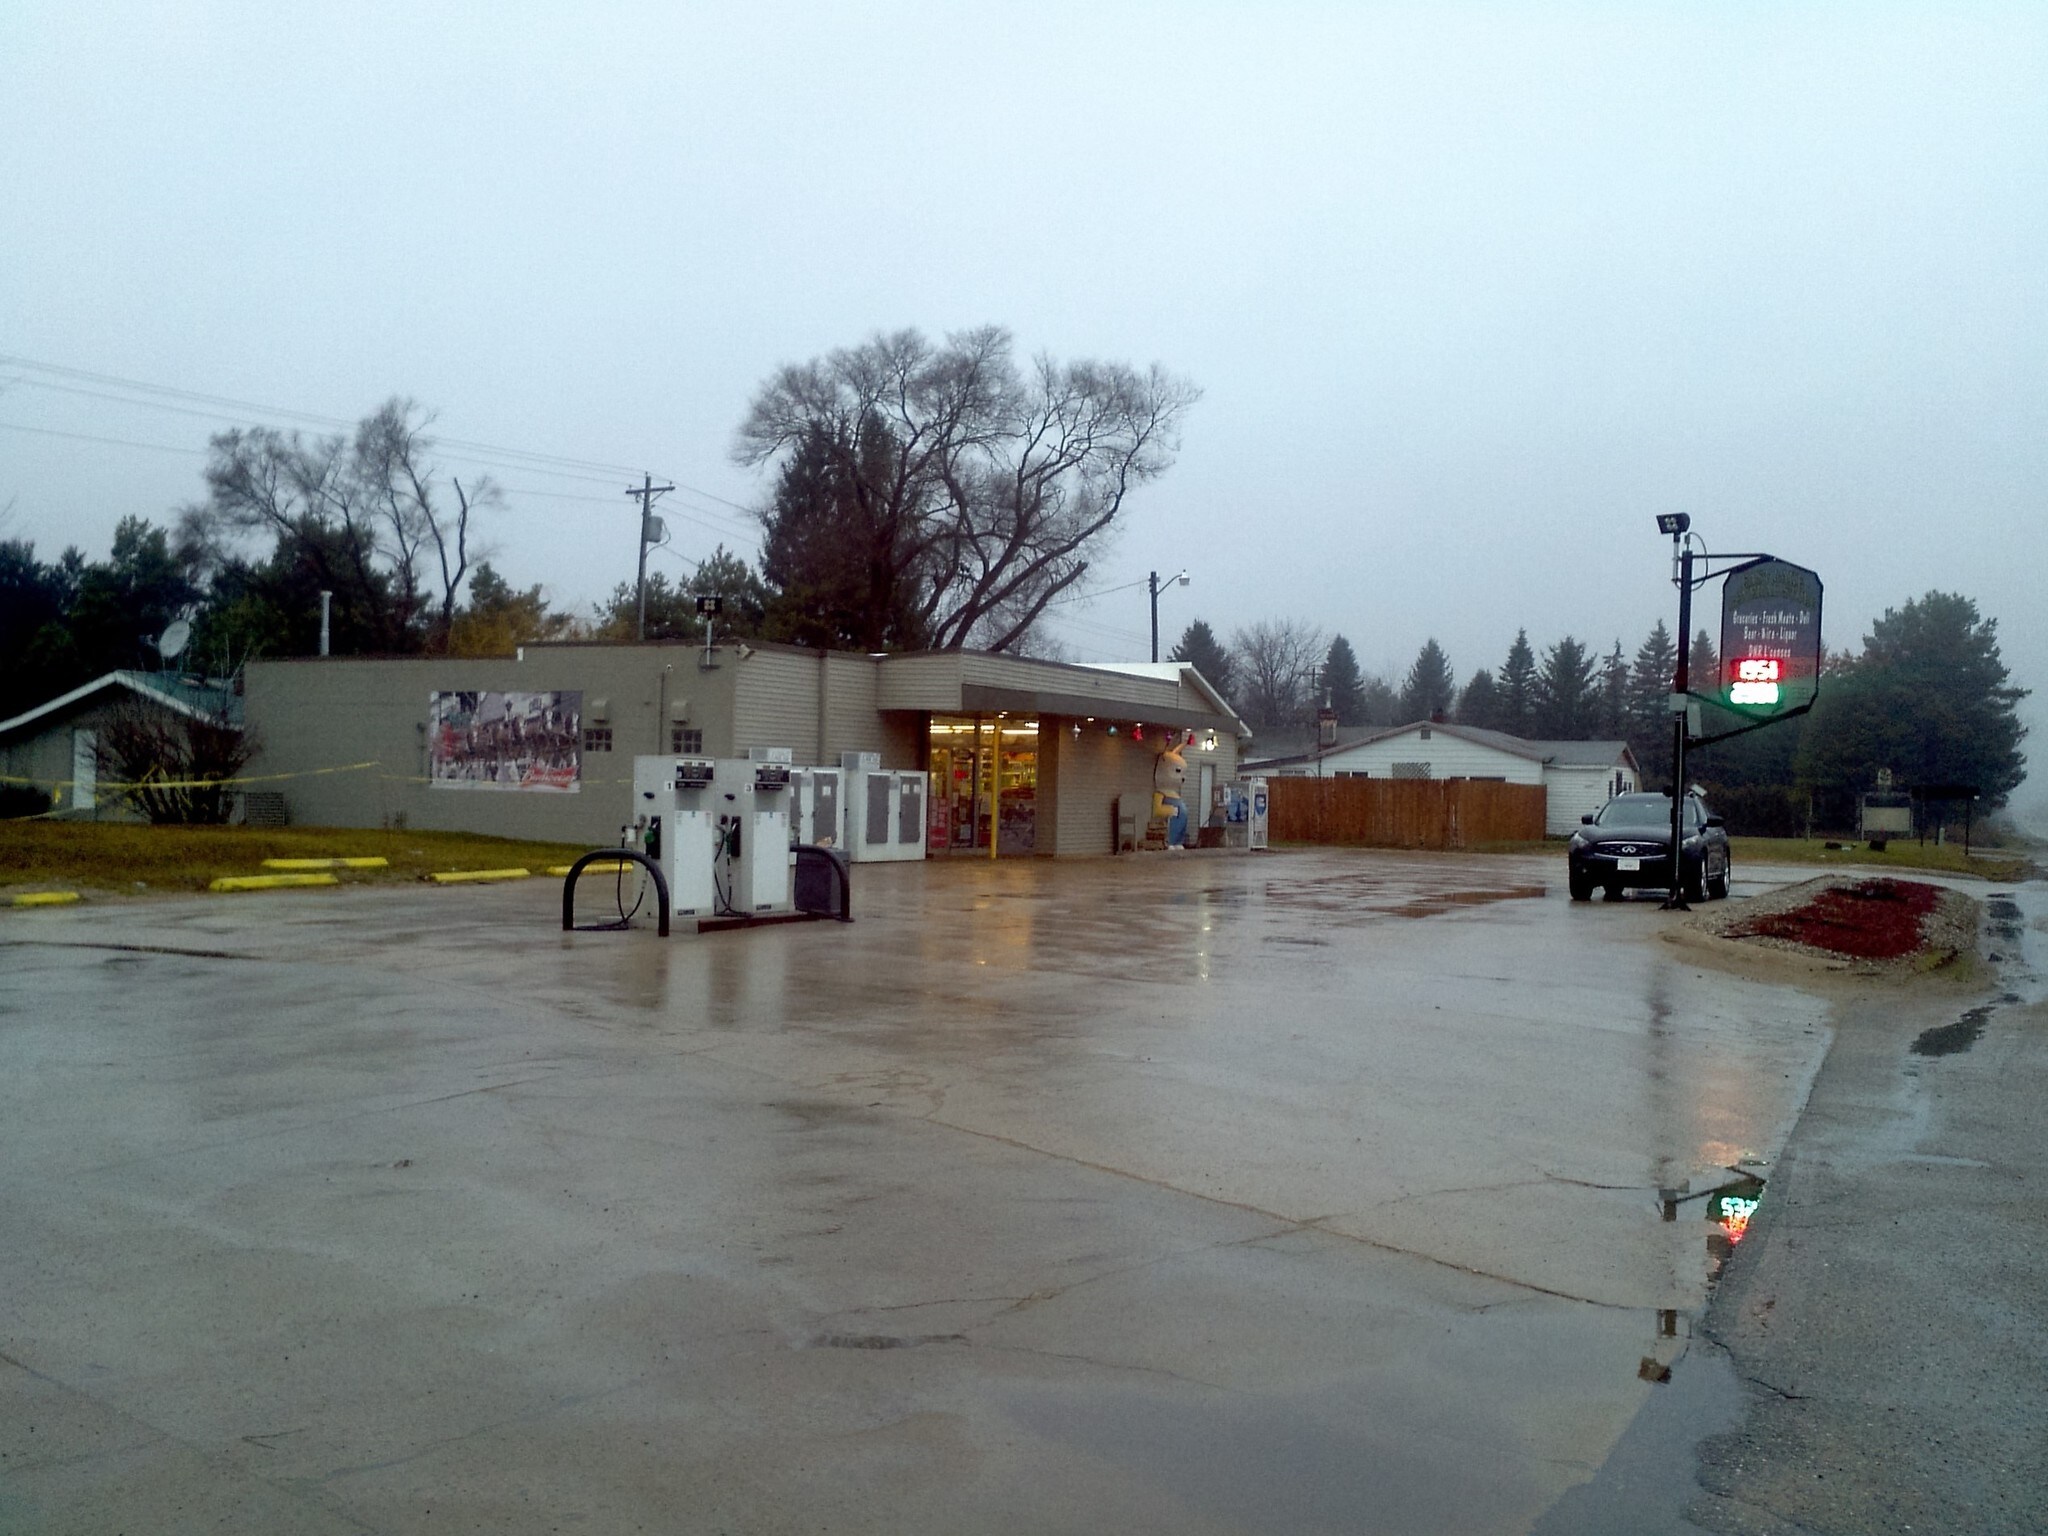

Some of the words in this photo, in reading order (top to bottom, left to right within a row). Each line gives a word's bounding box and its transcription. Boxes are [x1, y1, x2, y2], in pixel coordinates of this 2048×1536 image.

[1733, 610, 1757, 624] Groceries
[1763, 610, 1776, 624] Fresh
[1777, 610, 1795, 624] Meats
[1799, 610, 1810, 624] Deli
[1744, 626, 1756, 640] Beer
[1780, 626, 1797, 643] Liquor
